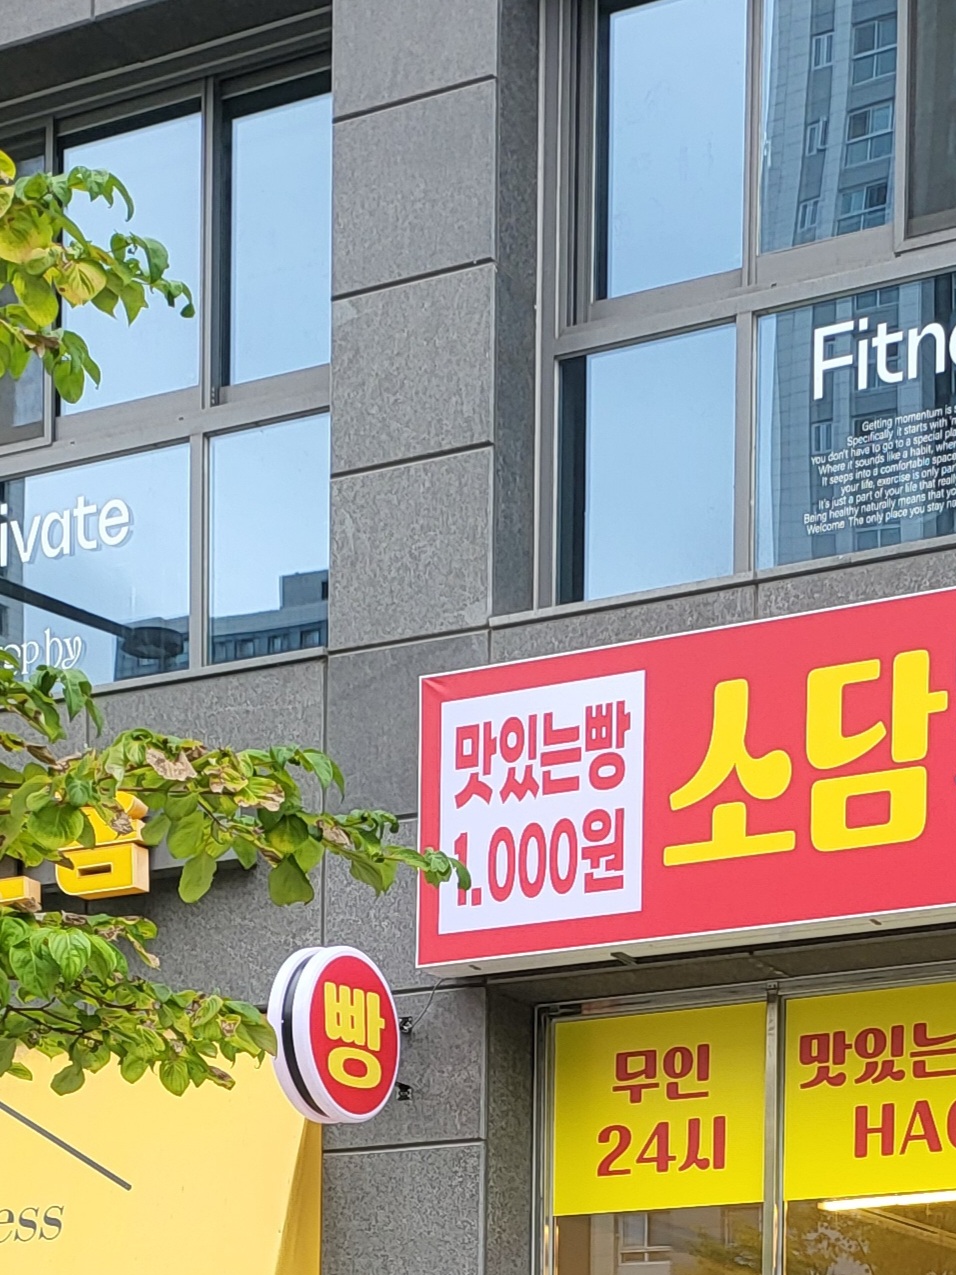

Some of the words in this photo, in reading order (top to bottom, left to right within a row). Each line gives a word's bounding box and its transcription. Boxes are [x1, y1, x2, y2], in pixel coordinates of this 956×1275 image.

[847, 429, 893, 447] Specifically
[904, 422, 928, 436] starts
[930, 418, 947, 430] with
[862, 418, 892, 431] Getting
[895, 408, 943, 423] momentum
[851, 445, 870, 457] have
[913, 430, 942, 446] special
[818, 463, 845, 475] Where
[855, 455, 884, 468] sounds
[887, 452, 900, 462] like
[829, 472, 853, 484] seeps
[856, 468, 871, 479] into
[880, 456, 930, 474] comfortable
[832, 495, 846, 510] just
[856, 491, 872, 504] part
[884, 486, 903, 499] your
[905, 482, 917, 493] life
[919, 479, 935, 490] that
[841, 483, 859, 496] your
[877, 472, 910, 487] exercise
[921, 466, 939, 479] only
[804, 512, 827, 525] Being
[829, 506, 859, 519] healthy
[861, 498, 895, 513] naturally
[897, 493, 926, 505] means
[928, 488, 944, 500] that
[806, 519, 845, 535] Welcome
[848, 516, 864, 527] The
[866, 512, 883, 523] only
[885, 507, 908, 522] place
[909, 506, 925, 518] you
[927, 502, 944, 513] stay
[0, 495, 129, 567] ivate
[454, 699, 631, 808] 맛있는빵
[663, 649, 949, 867] 소담
[324, 981, 385, 1090] 빵
[612, 1043, 711, 1104] 무인
[597, 1116, 726, 1177] 24시
